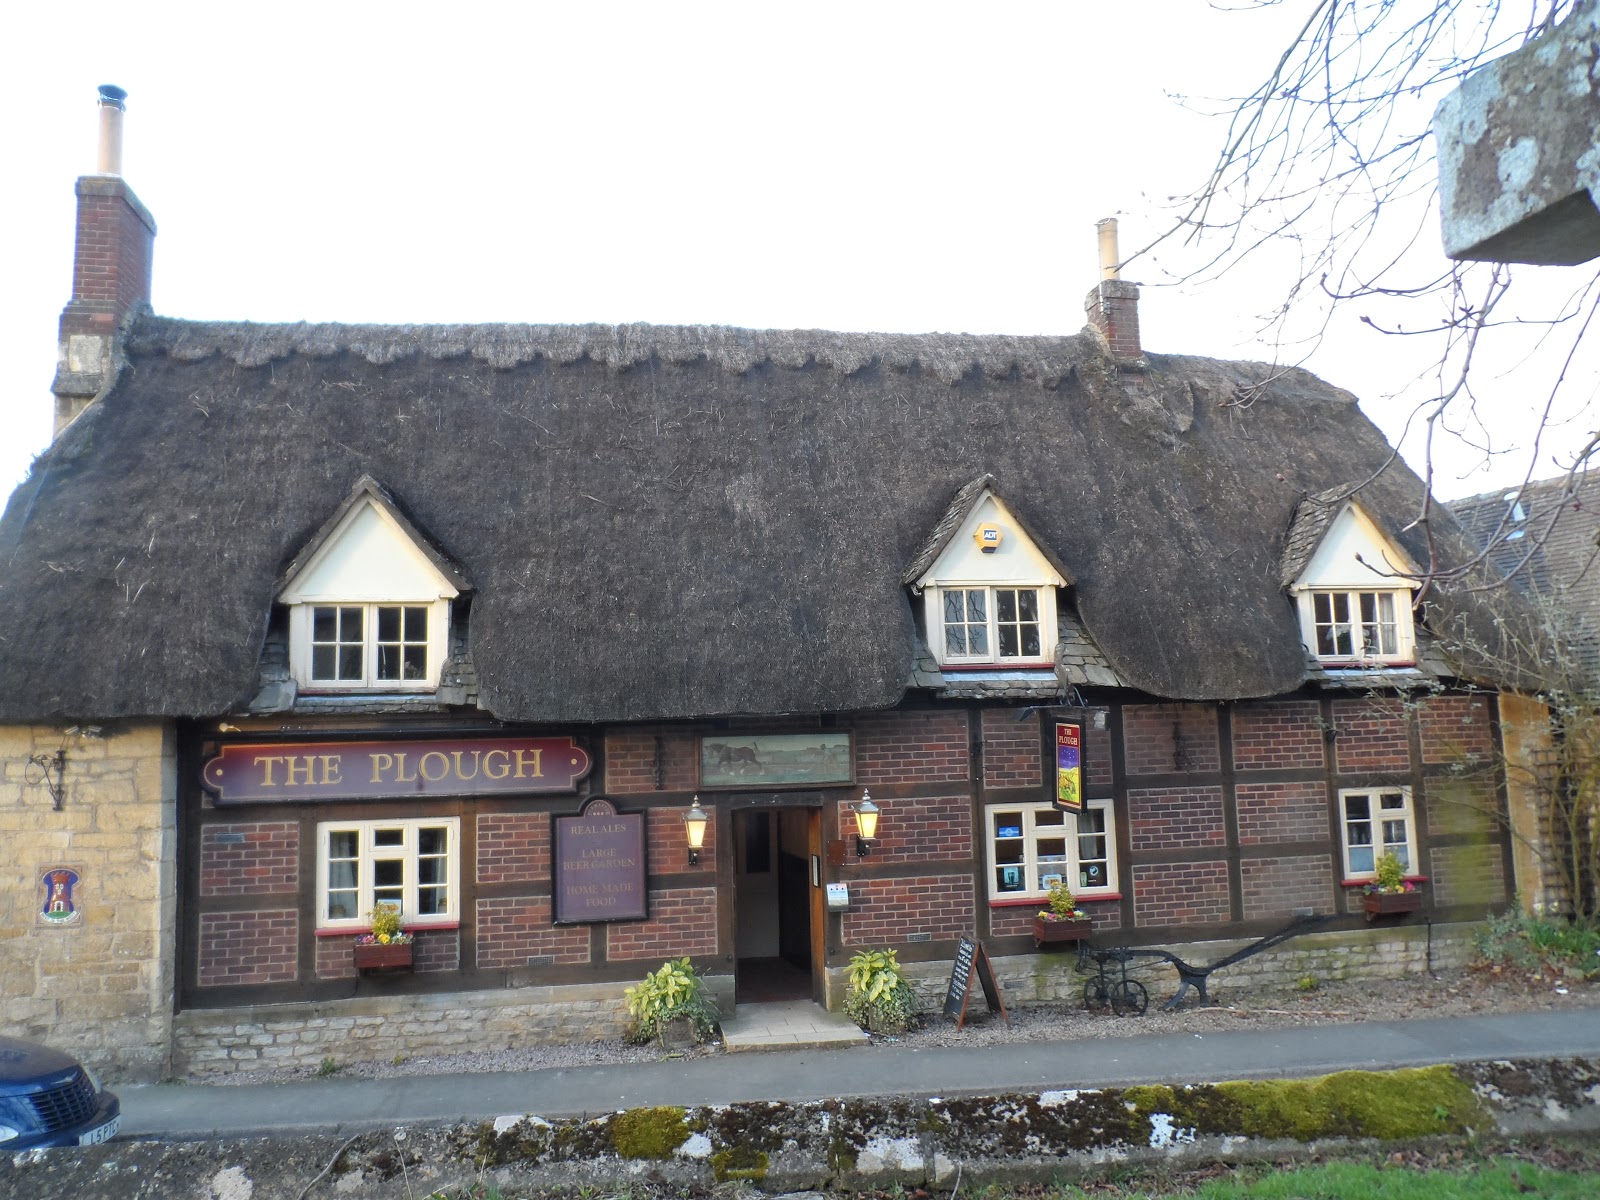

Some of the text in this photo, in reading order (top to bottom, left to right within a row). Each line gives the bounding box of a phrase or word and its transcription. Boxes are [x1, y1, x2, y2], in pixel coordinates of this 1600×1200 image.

[984, 531, 997, 539] ADT
[1063, 728, 1072, 736] THE
[1058, 735, 1078, 746] PLOUGH
[253, 749, 544, 786] THE PLOUGH
[571, 823, 627, 835] REAL ALES
[582, 848, 616, 858] LARGE
[563, 859, 635, 871] BEER GARDEN
[566, 882, 633, 896] HOME MADE
[586, 897, 616, 907] FOOD
